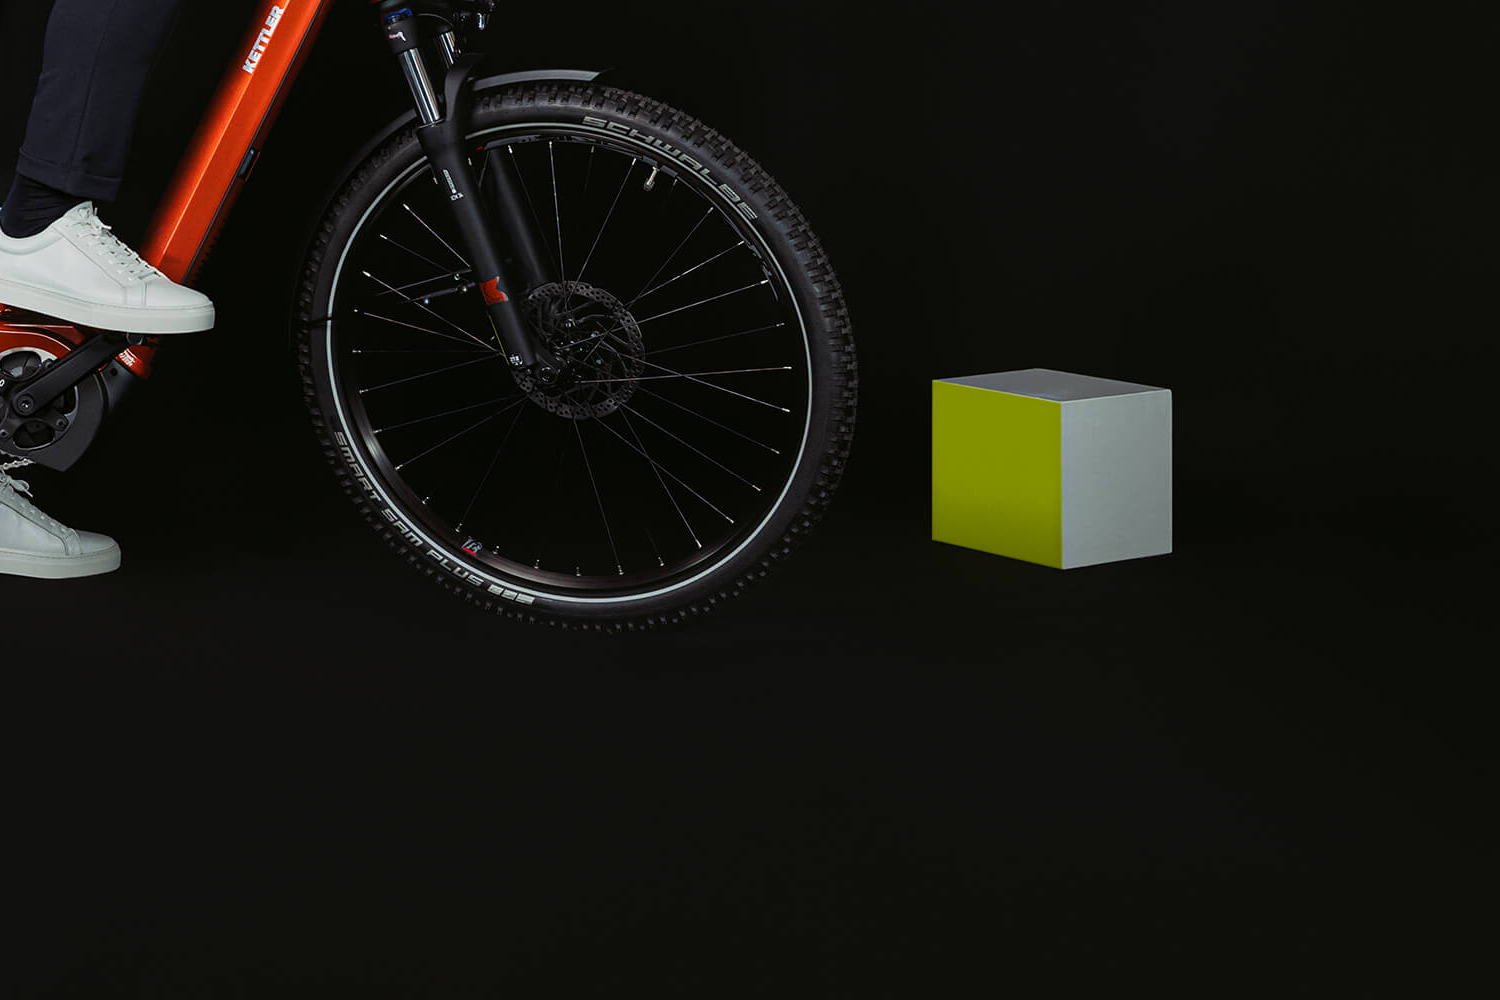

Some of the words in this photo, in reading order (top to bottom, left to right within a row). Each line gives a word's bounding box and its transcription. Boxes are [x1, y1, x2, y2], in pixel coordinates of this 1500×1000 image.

[241, 4, 285, 75] KETTLER
[581, 115, 759, 220] SCHWALBE
[334, 430, 383, 503] SMART
[381, 507, 425, 548] SAM
[426, 548, 485, 588] PLUS
